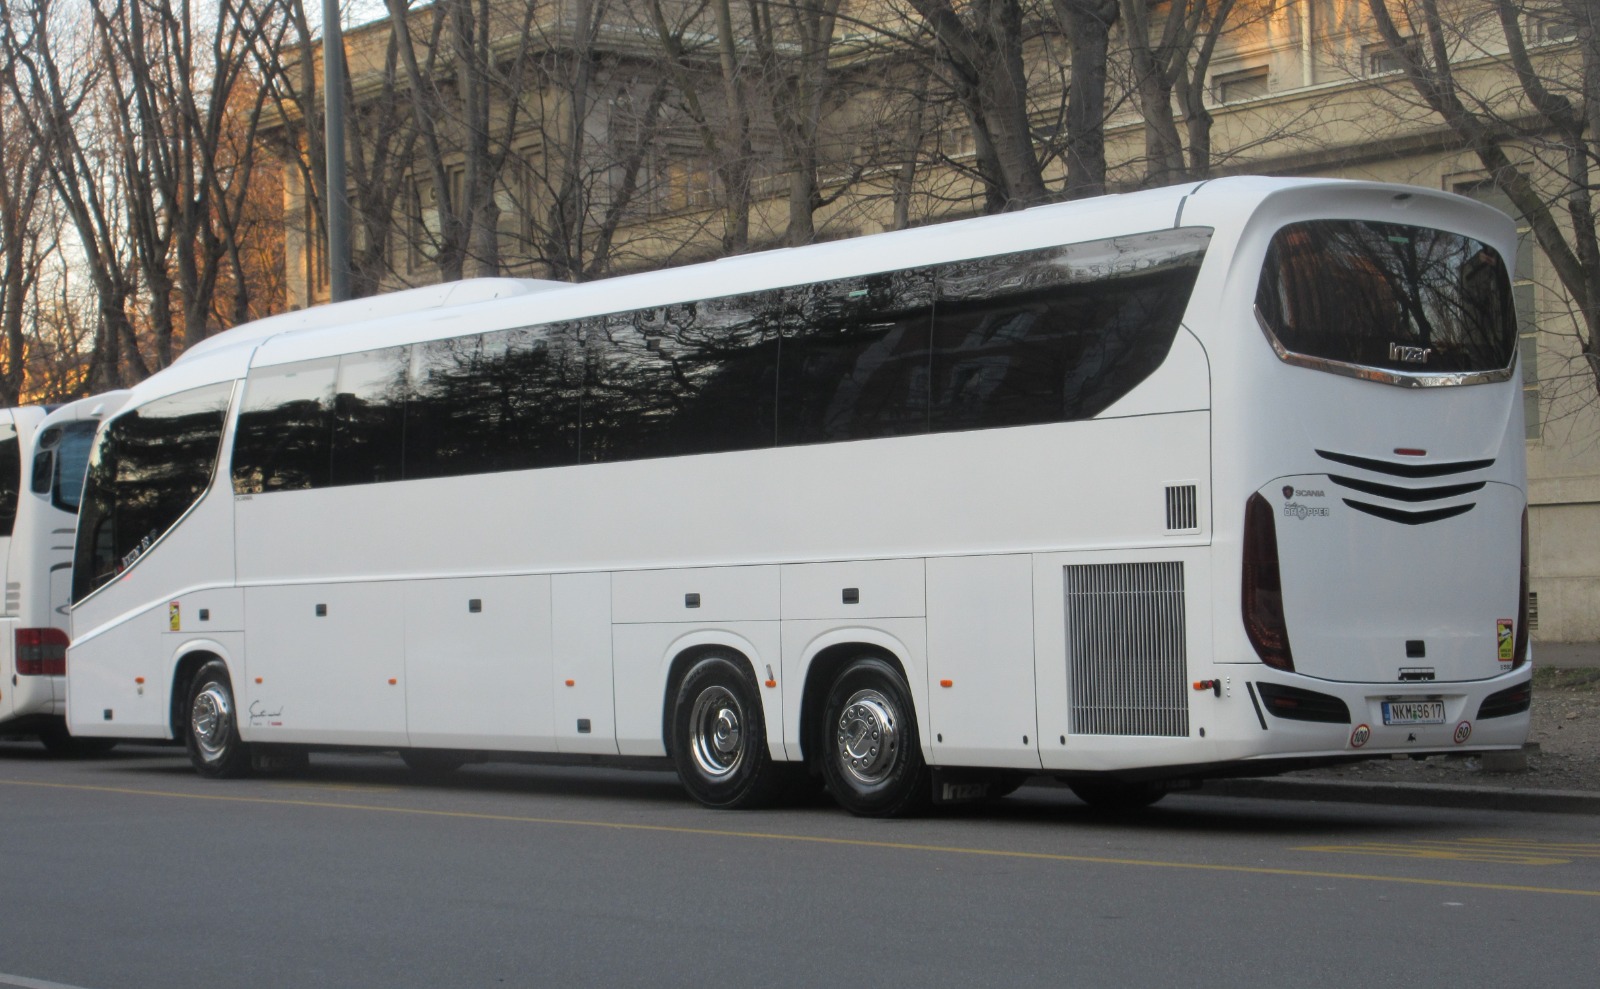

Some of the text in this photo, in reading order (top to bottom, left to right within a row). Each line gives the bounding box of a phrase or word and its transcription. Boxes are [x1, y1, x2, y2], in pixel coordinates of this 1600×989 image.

[1392, 704, 1442, 719] NKM 9617
[1354, 729, 1368, 742] 100
[1457, 726, 1469, 738] 80
